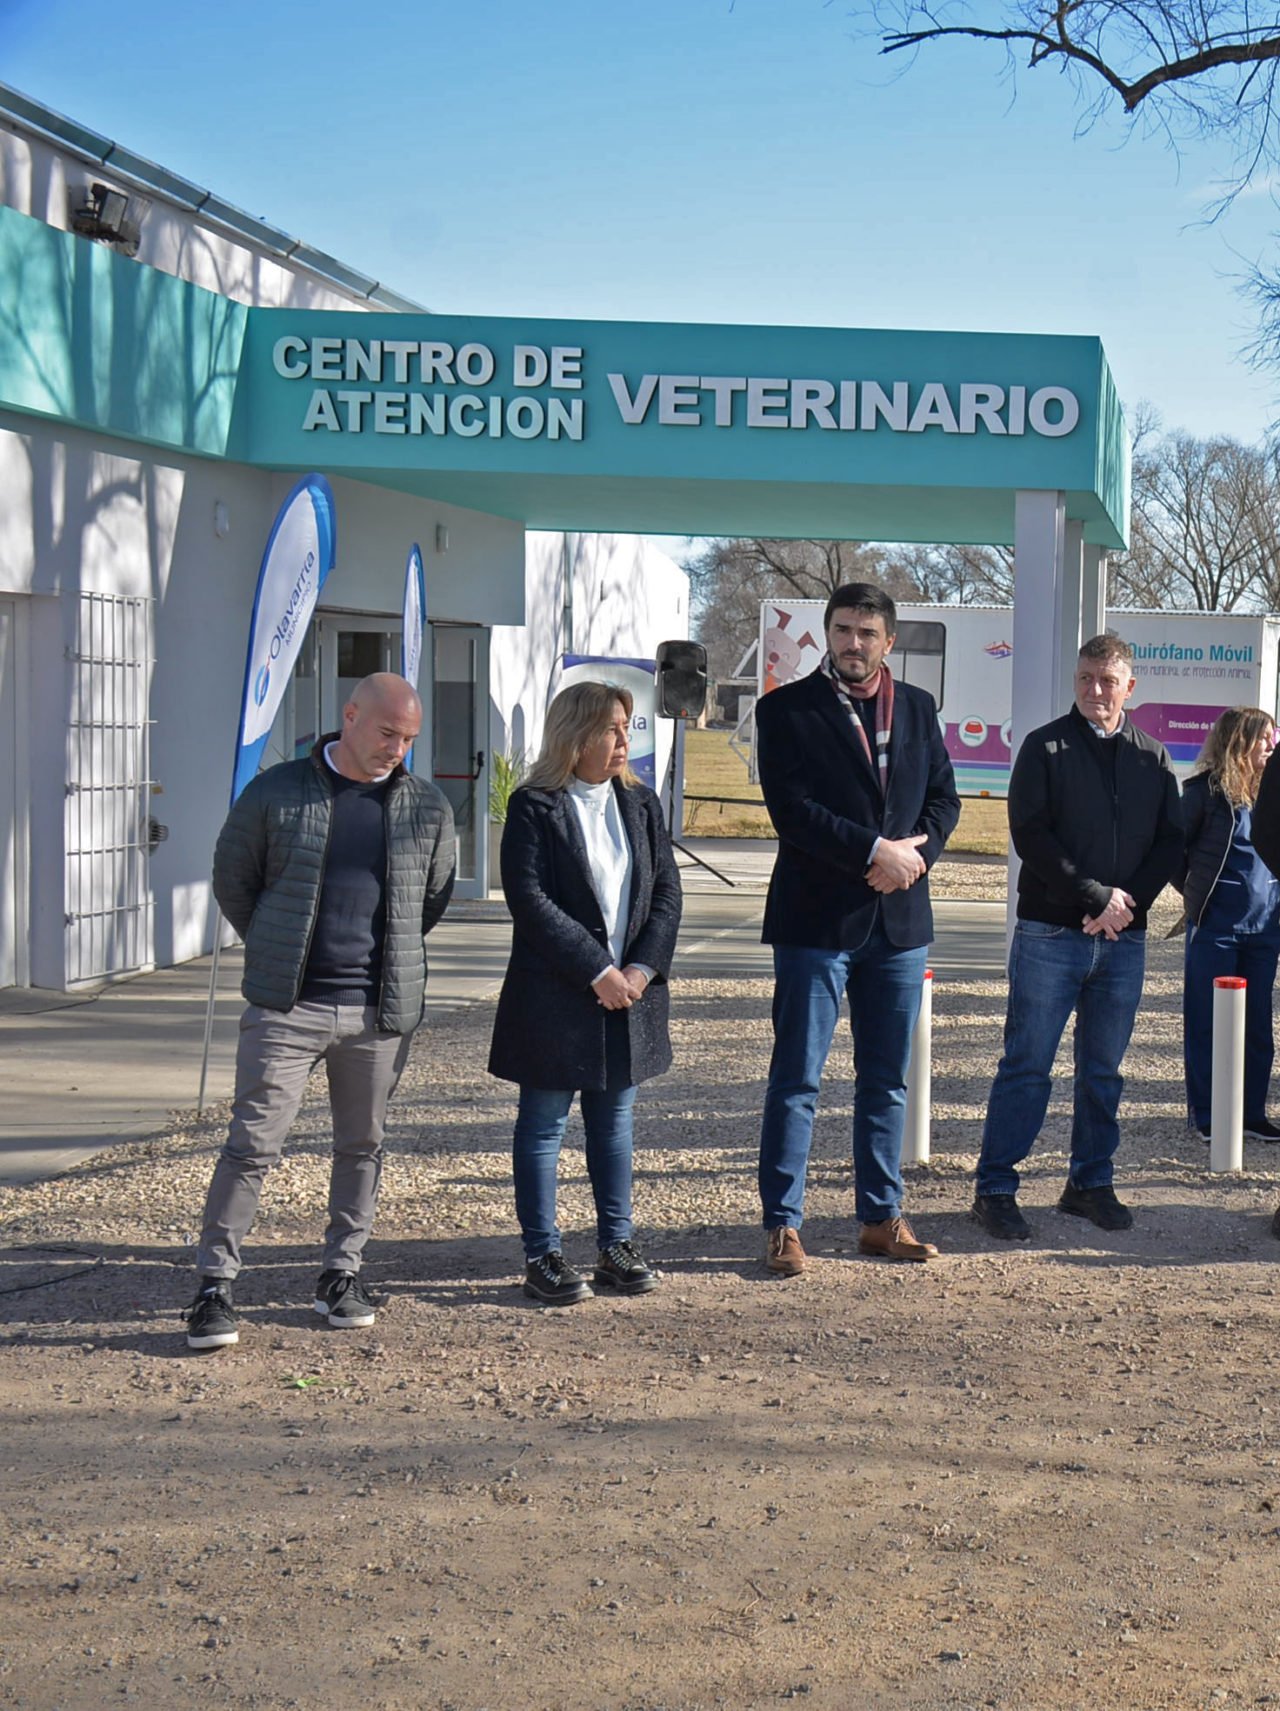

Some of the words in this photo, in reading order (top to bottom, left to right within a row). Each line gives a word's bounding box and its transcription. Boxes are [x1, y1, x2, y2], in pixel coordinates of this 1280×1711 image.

[272, 335, 495, 386] CENTRO
[512, 344, 585, 391] DE
[302, 388, 586, 441] ATENCION
[606, 373, 1080, 438] VETERINARIO
[1209, 644, 1253, 662] Móvil
[1168, 720, 1200, 729] Dirección
[1200, 721, 1209, 730] de
